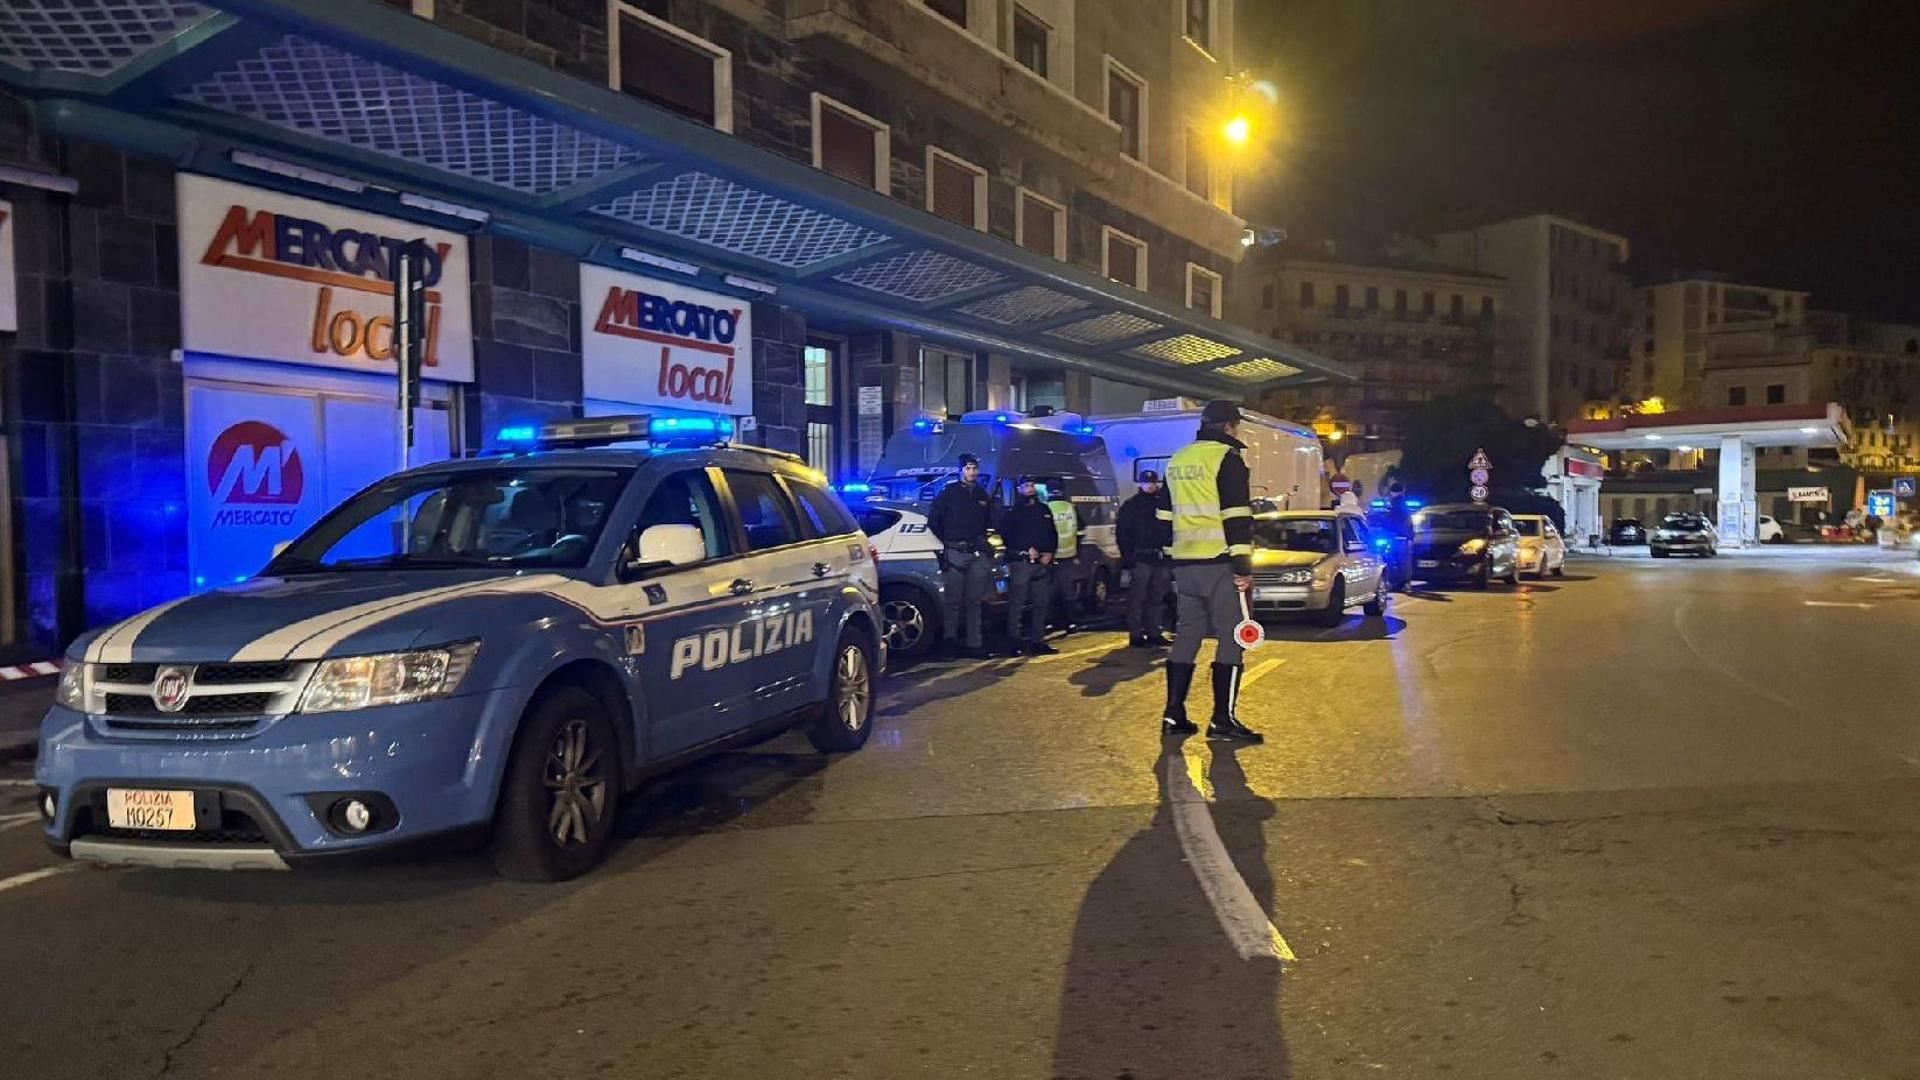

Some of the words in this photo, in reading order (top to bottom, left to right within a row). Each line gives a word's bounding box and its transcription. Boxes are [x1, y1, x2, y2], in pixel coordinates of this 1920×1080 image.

[312, 287, 442, 367] locl
[594, 286, 742, 344] MERCATO
[658, 347, 735, 405] local
[210, 508, 298, 530] MERCATO
[900, 523, 928, 534] 113
[670, 608, 813, 681] POLIZIA
[125, 792, 173, 806] POLIZIA
